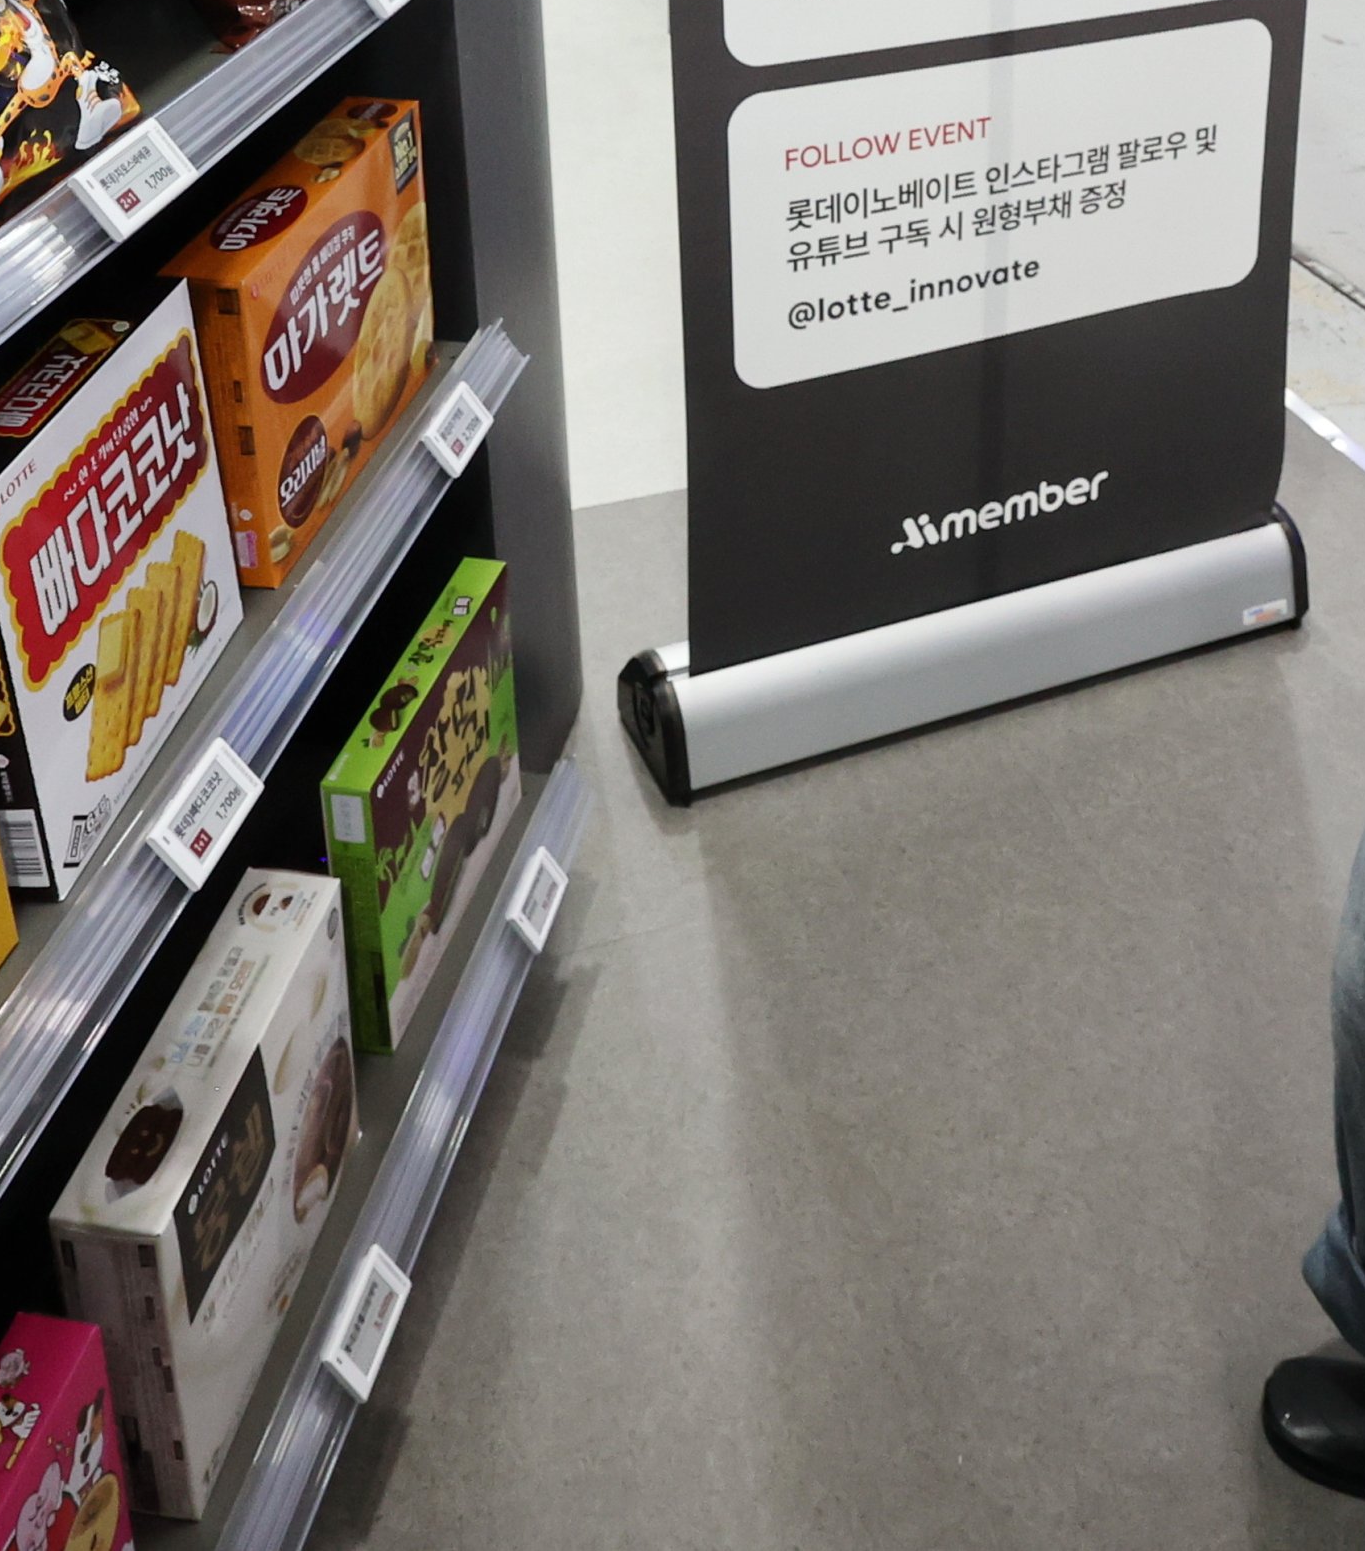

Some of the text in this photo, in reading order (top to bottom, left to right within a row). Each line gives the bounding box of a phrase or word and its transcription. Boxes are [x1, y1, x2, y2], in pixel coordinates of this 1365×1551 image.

[785, 117, 992, 171] FOLLOW EVENT
[785, 123, 1218, 233] 롯데이노베이트 인스타그램 팔로우 및
[786, 180, 1127, 273] 유튜브 구독 시 원형부채 증정
[263, 228, 385, 395] 마가렛트
[786, 256, 1041, 332] @lotte_innovate
[0, 459, 37, 507] LOTTE
[29, 380, 197, 637] 빠다코코낫
[279, 435, 329, 509] 오리지널
